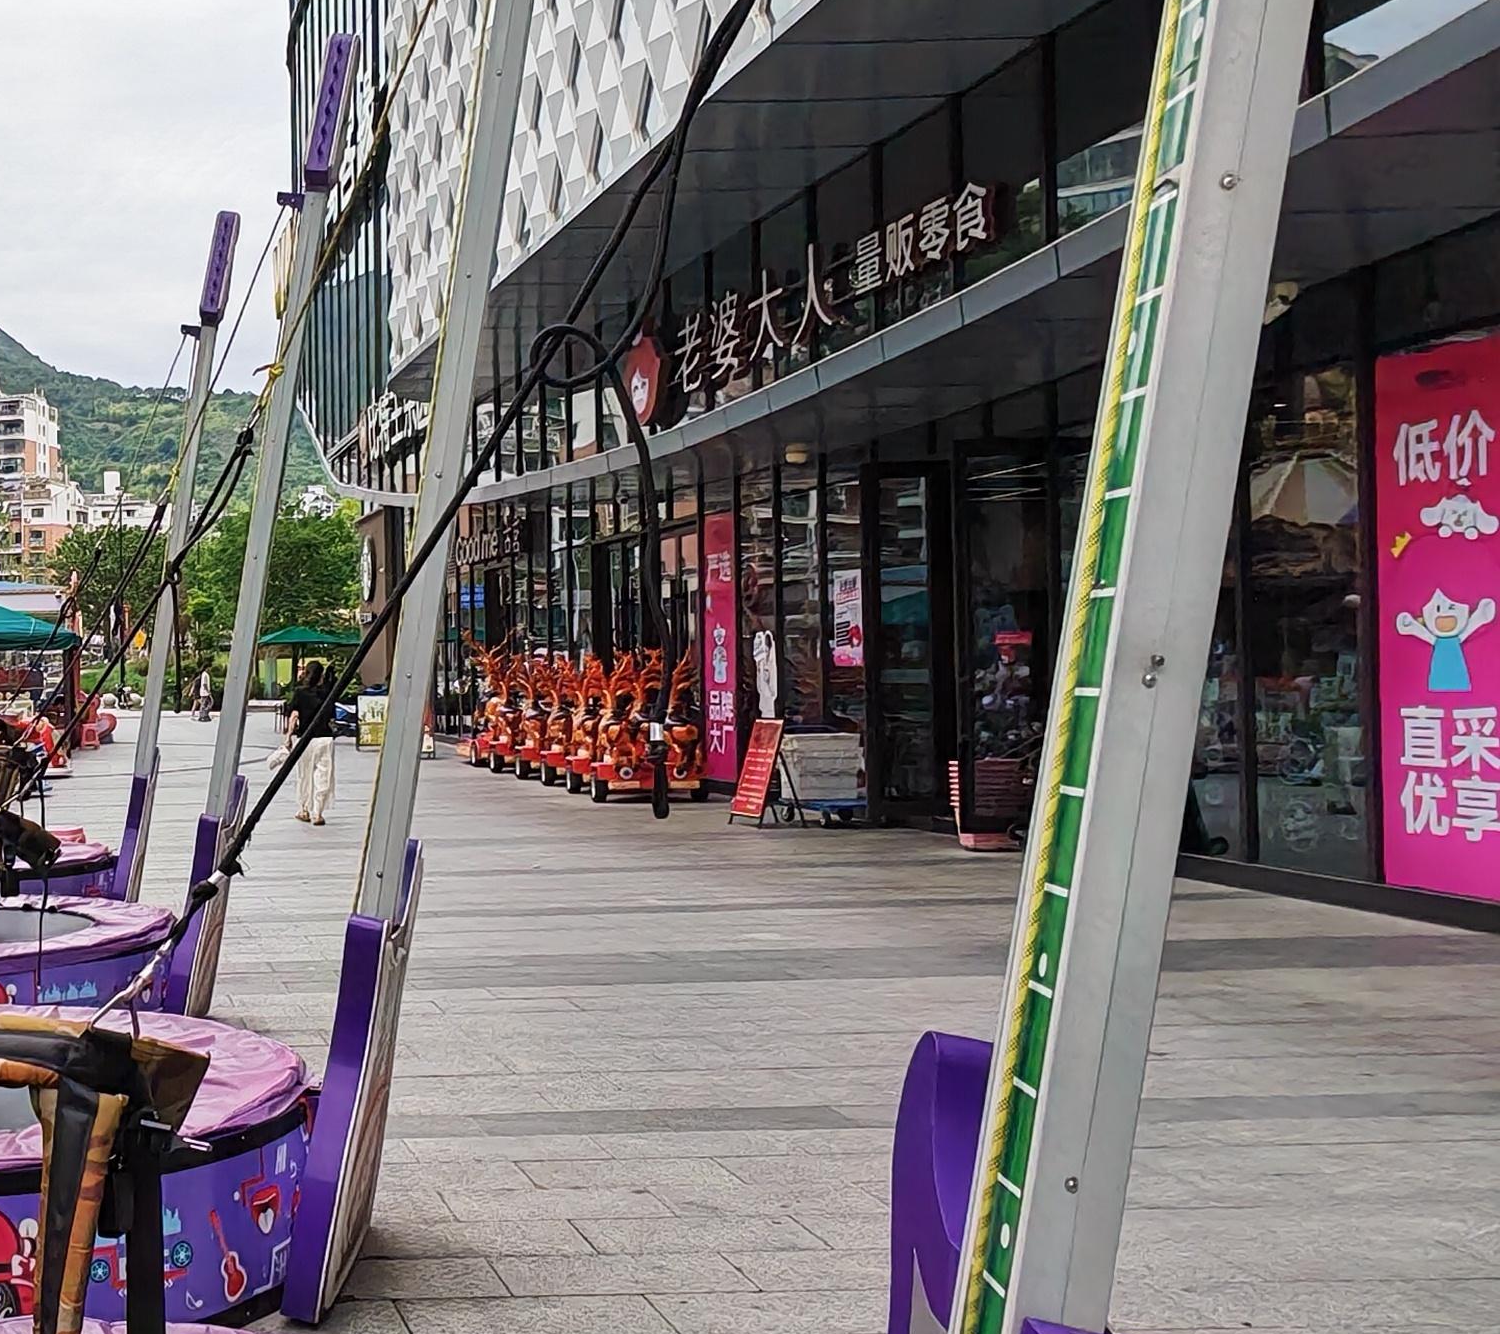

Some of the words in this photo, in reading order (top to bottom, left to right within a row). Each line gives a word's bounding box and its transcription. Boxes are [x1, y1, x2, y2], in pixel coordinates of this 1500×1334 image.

[674, 243, 833, 393] 老婆大人
[854, 182, 988, 296] 量贩零食
[1393, 409, 1495, 487] 低价
[709, 723, 735, 755] 大厂
[1400, 705, 1500, 772] 直采
[1400, 770, 1500, 842] 优享
